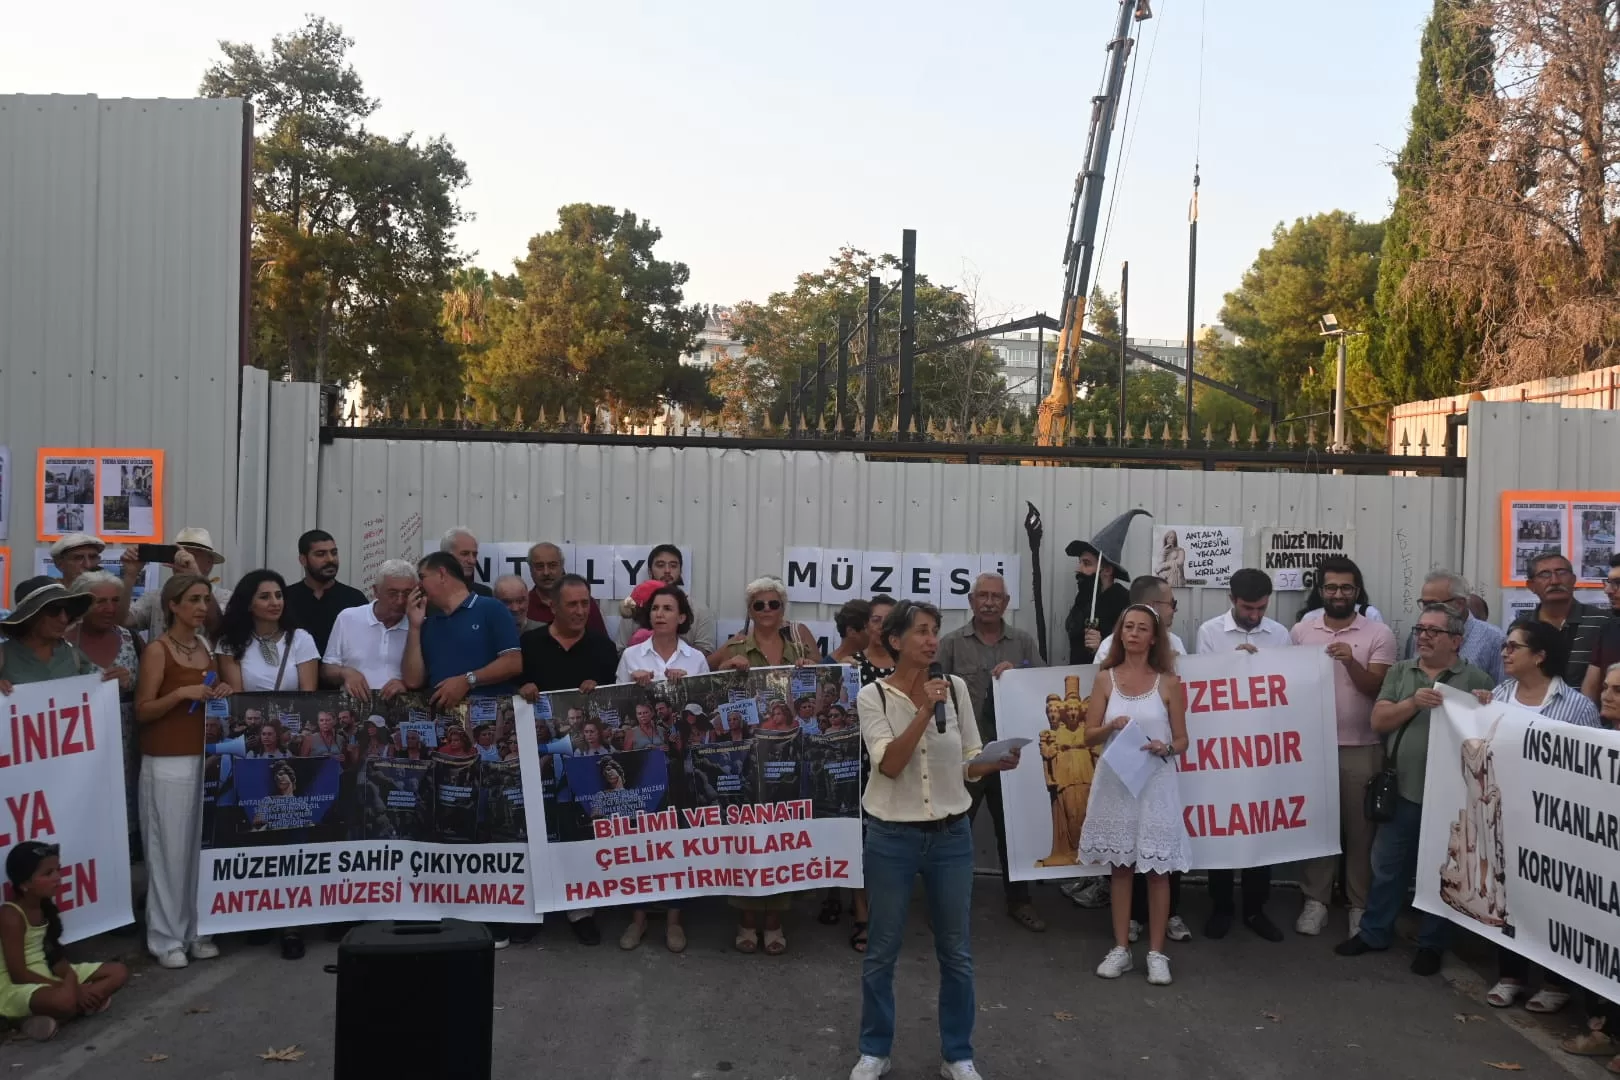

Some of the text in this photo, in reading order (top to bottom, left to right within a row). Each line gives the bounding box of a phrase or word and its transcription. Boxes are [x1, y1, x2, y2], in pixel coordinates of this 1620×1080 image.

[1186, 530, 1223, 541] ANTALYA
[1196, 548, 1232, 557] YIKACAK
[1272, 530, 1343, 550] MÜZE'MİZİN
[1188, 559, 1213, 568] ELLER
[1280, 573, 1298, 588] 37
[1176, 731, 1302, 772] LKINDIR
[1522, 720, 1620, 786] İNSANLIK T
[0, 790, 55, 848] YA
[684, 806, 721, 827] VE
[726, 799, 813, 825] SANATI
[212, 845, 525, 881] MÜZEMİZE SAHİP ÇIKIYORUZ
[595, 830, 812, 871] ÇELİK KUTULARA
[210, 876, 525, 914] ANTALYA MÜZESİ YIKILAMAZ
[565, 857, 849, 901] HAPSETTİRMEYECEĞİZ
